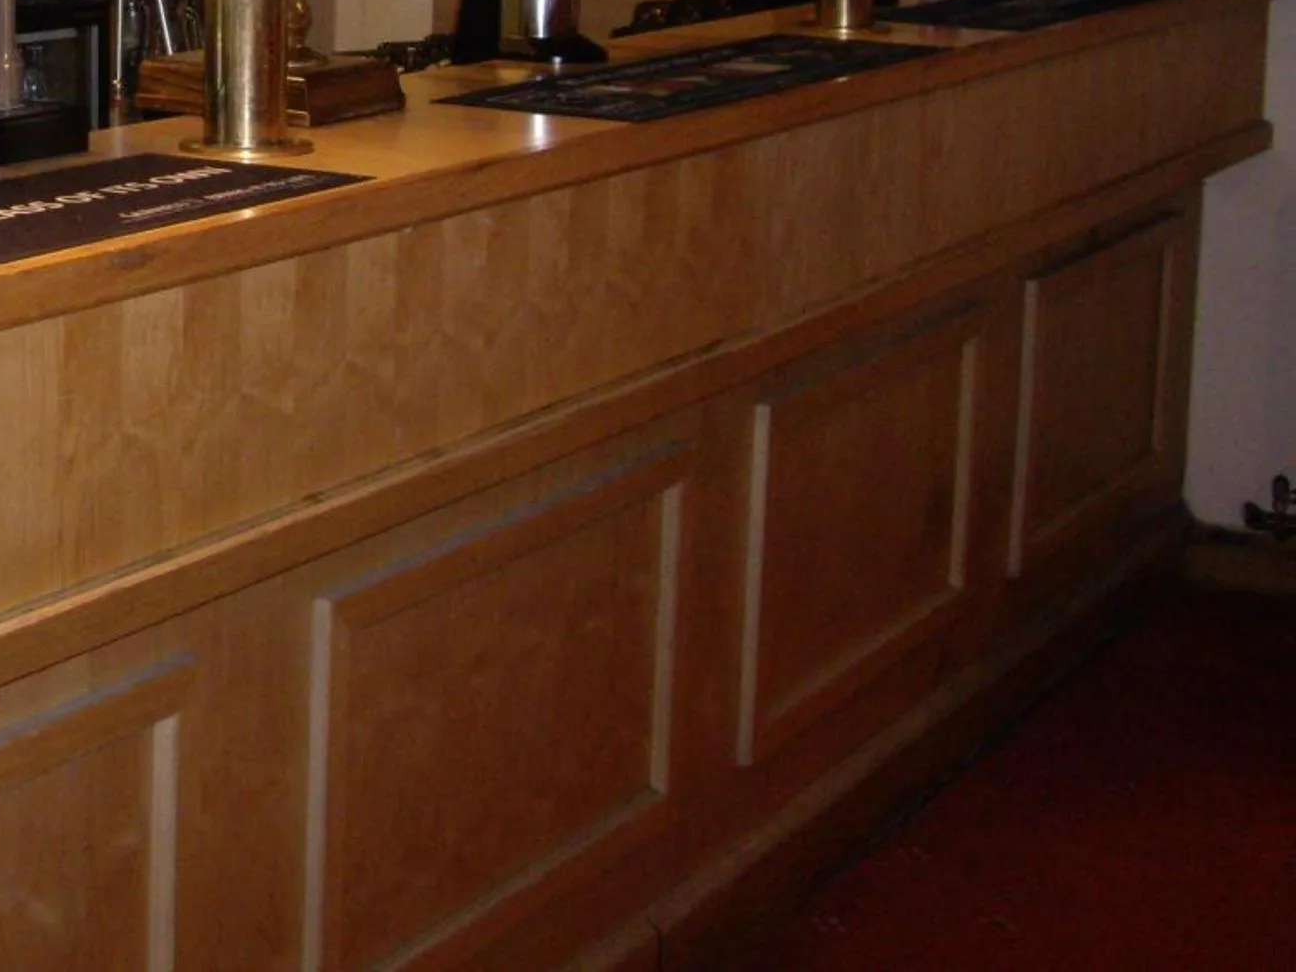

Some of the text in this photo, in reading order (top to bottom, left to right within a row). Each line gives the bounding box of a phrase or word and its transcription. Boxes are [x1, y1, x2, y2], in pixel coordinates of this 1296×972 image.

[55, 191, 106, 204] OF
[99, 180, 160, 197] ITS
[148, 166, 234, 185] OWN
